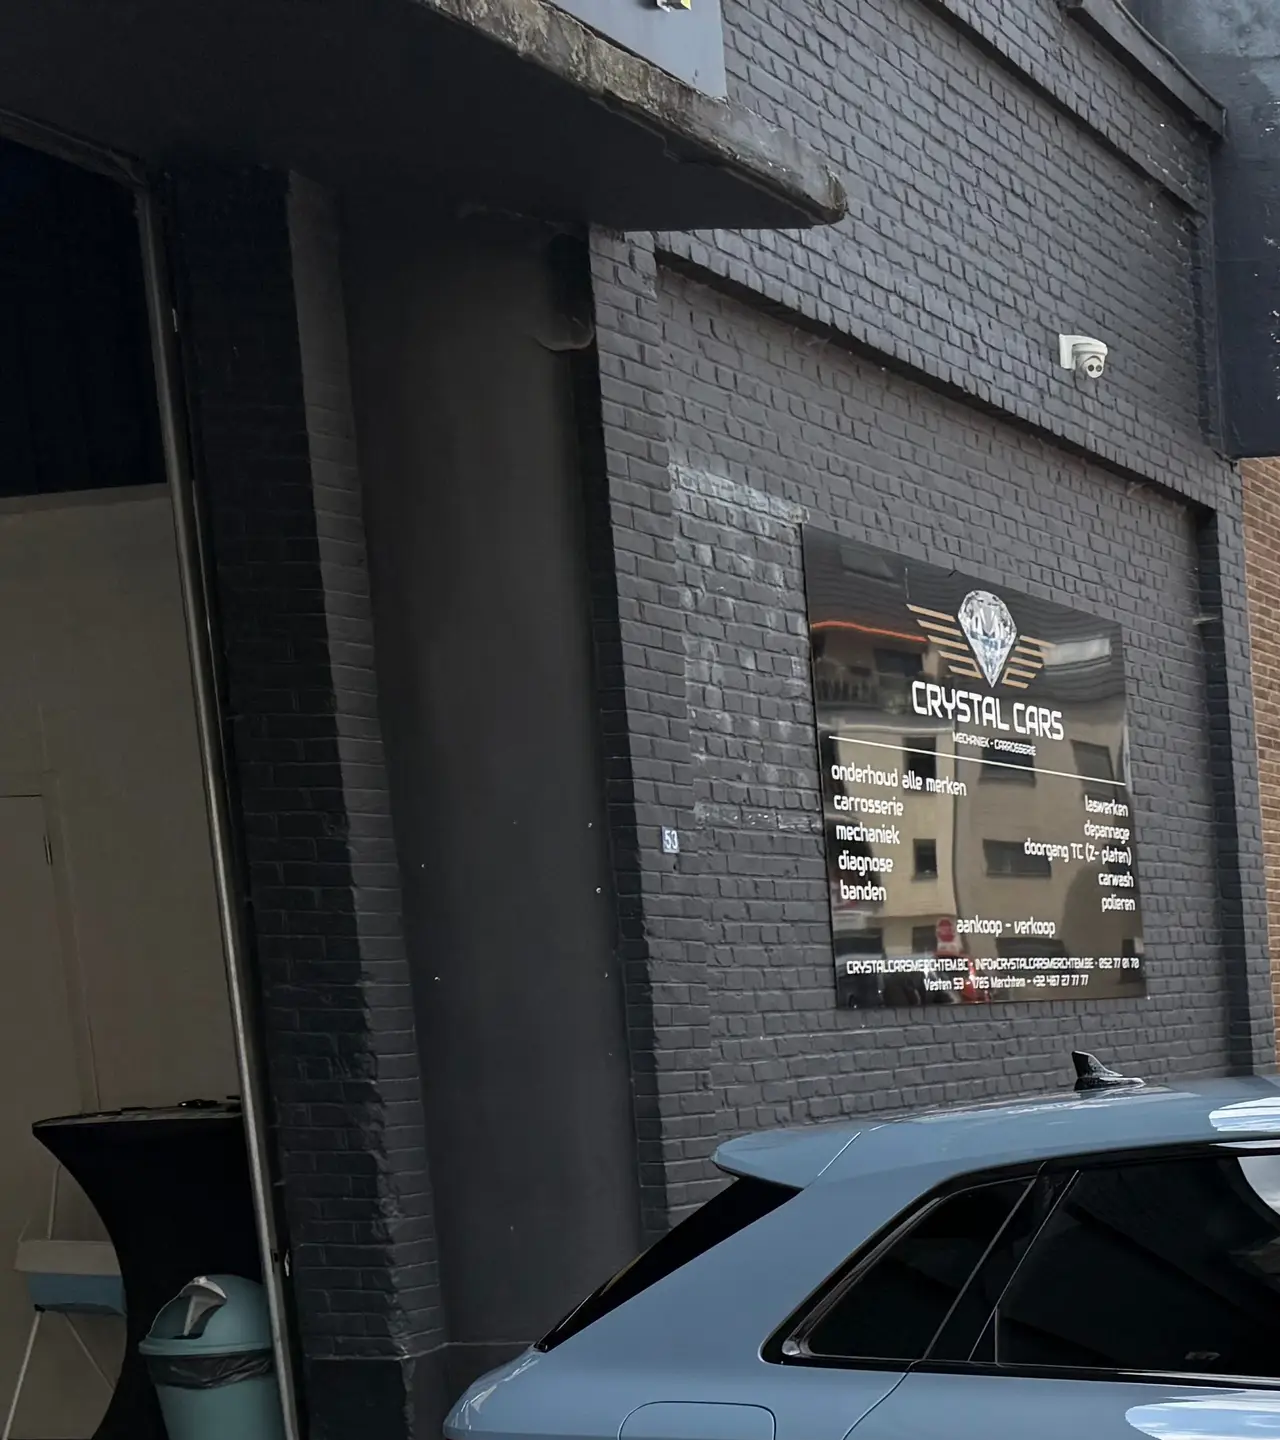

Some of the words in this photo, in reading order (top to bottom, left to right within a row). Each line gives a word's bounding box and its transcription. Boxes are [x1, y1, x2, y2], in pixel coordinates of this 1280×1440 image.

[912, 680, 1010, 731] CRYSTAL
[1013, 702, 1064, 741] CARS
[831, 762, 899, 787] onderhoud
[902, 769, 923, 790] alle
[925, 776, 967, 796] merken
[833, 795, 904, 816] carrosserie
[1084, 794, 1129, 817] laswerken
[664, 829, 679, 850] 53
[836, 821, 900, 844] mechaniek
[1084, 819, 1130, 844] depannage
[1024, 837, 1069, 863] doorgang
[1070, 842, 1084, 860] TC
[838, 849, 894, 877] diagnose
[840, 879, 887, 901] banden
[1098, 871, 1134, 888] carwash
[1101, 893, 1136, 913] polieren
[956, 915, 1002, 937] aankoop
[1014, 915, 1056, 938] verkoop
[923, 977, 952, 992] Vesten
